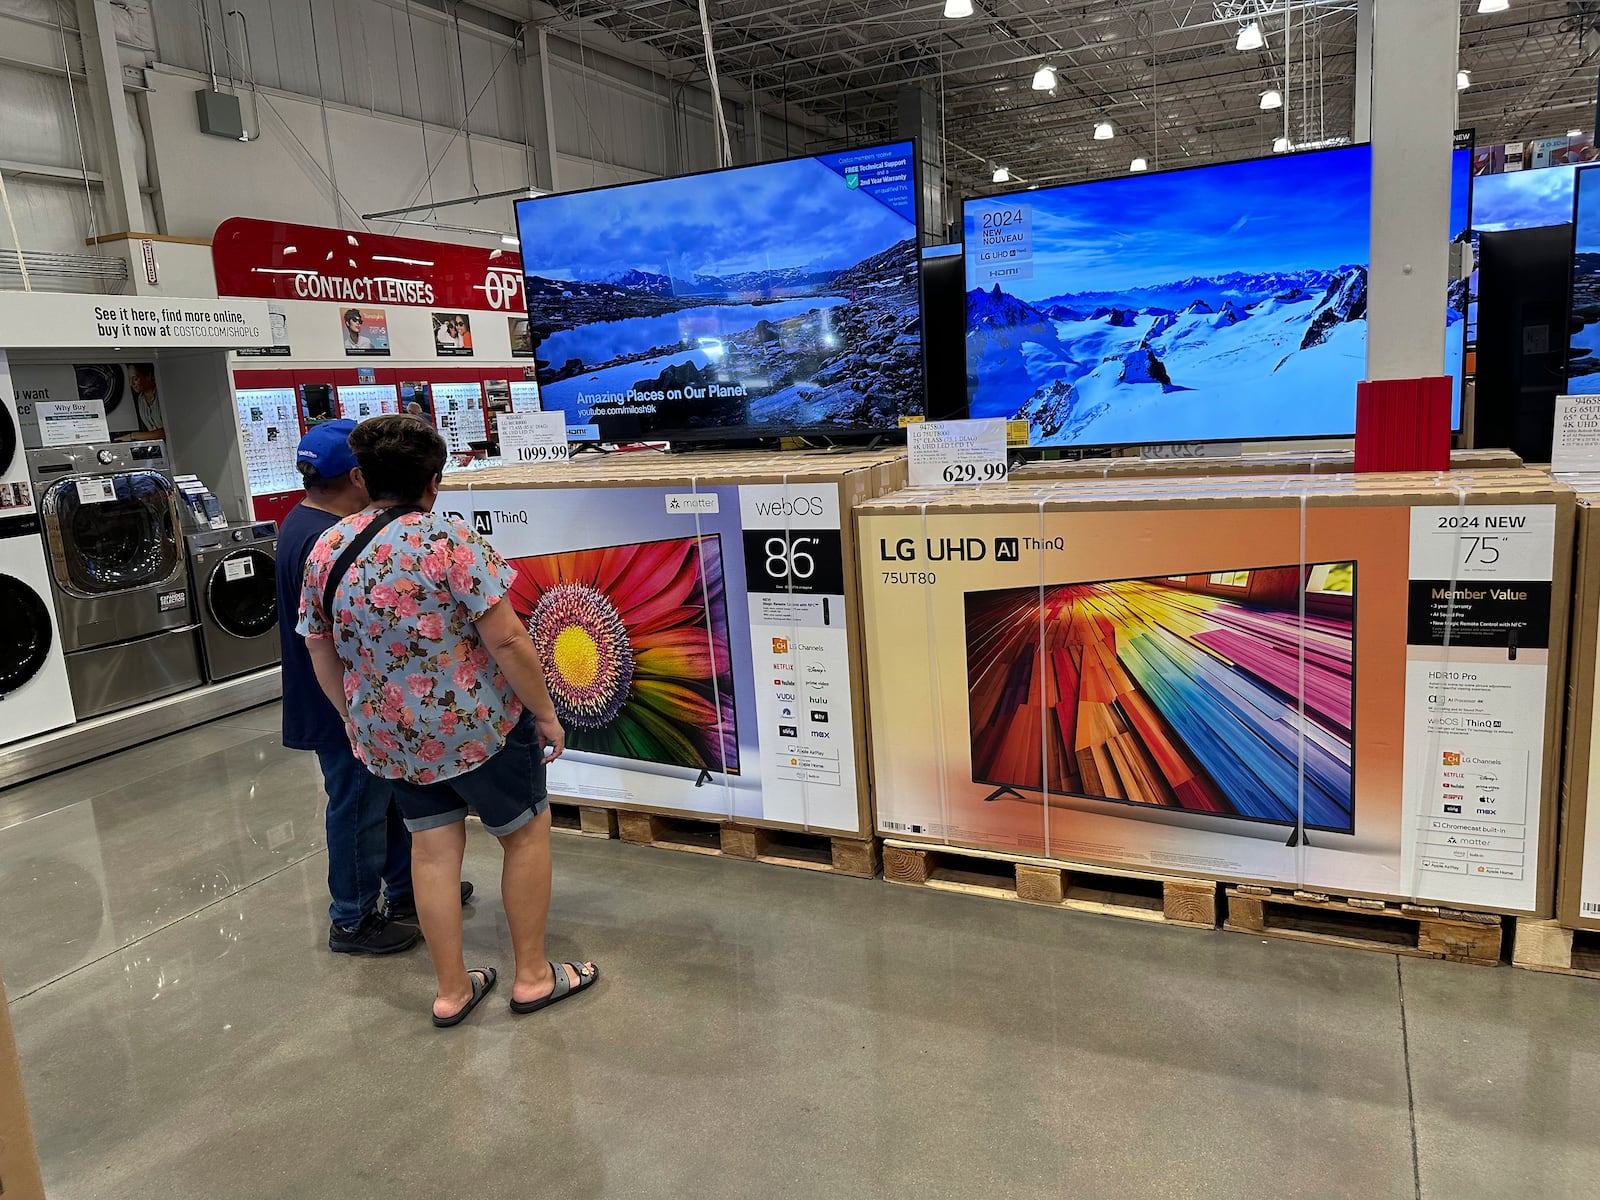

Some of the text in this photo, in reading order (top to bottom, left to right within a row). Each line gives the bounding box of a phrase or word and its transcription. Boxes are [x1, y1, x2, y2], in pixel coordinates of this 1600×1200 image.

[1454, 133, 1471, 141] NEW
[844, 158, 907, 174] FREE Technical Support
[860, 173, 907, 186] 2nd Year Warranty
[983, 208, 1023, 229] 2024
[983, 229, 1002, 237] NEW
[983, 233, 1024, 245] NOUVEAU
[980, 253, 991, 261] LG
[992, 251, 1009, 259] UHD
[294, 273, 373, 301] CONTACT
[376, 280, 434, 305] LENSES
[94, 306, 246, 325] See it here, find more online,
[97, 323, 259, 338] buy it now at COSTCO.COM/SHOPLG
[22, 388, 50, 399] want
[576, 383, 748, 406] Amazing Places on Our Planet
[54, 403, 86, 412] Why Buy
[577, 404, 657, 418] youtube.com/milosh9k
[517, 445, 567, 461] 1099.99
[943, 463, 1007, 482] 629.99
[682, 498, 715, 507] matter
[755, 496, 824, 517] webOS
[475, 515, 491, 531] AI
[493, 510, 528, 525] ThinQ
[1438, 516, 1526, 528] 2024 NEW
[880, 536, 1064, 561] LG UHD AI ThinQ
[764, 537, 820, 579] 86"
[881, 572, 936, 584] 75UT80
[1431, 588, 1528, 600] Member Value
[797, 643, 824, 652] Channels
[773, 663, 794, 671] NETFLIX
[1428, 671, 1459, 680] HDR10
[776, 693, 828, 704] VUDU hulu
[1427, 718, 1459, 726] wbOS
[1466, 719, 1492, 728] ThinQ
[810, 730, 830, 739] max
[1472, 757, 1502, 765] Channels
[1486, 796, 1496, 804] tv
[1476, 808, 1497, 816] max
[1441, 822, 1482, 832] Chromecast
[1460, 838, 1491, 846] matter
